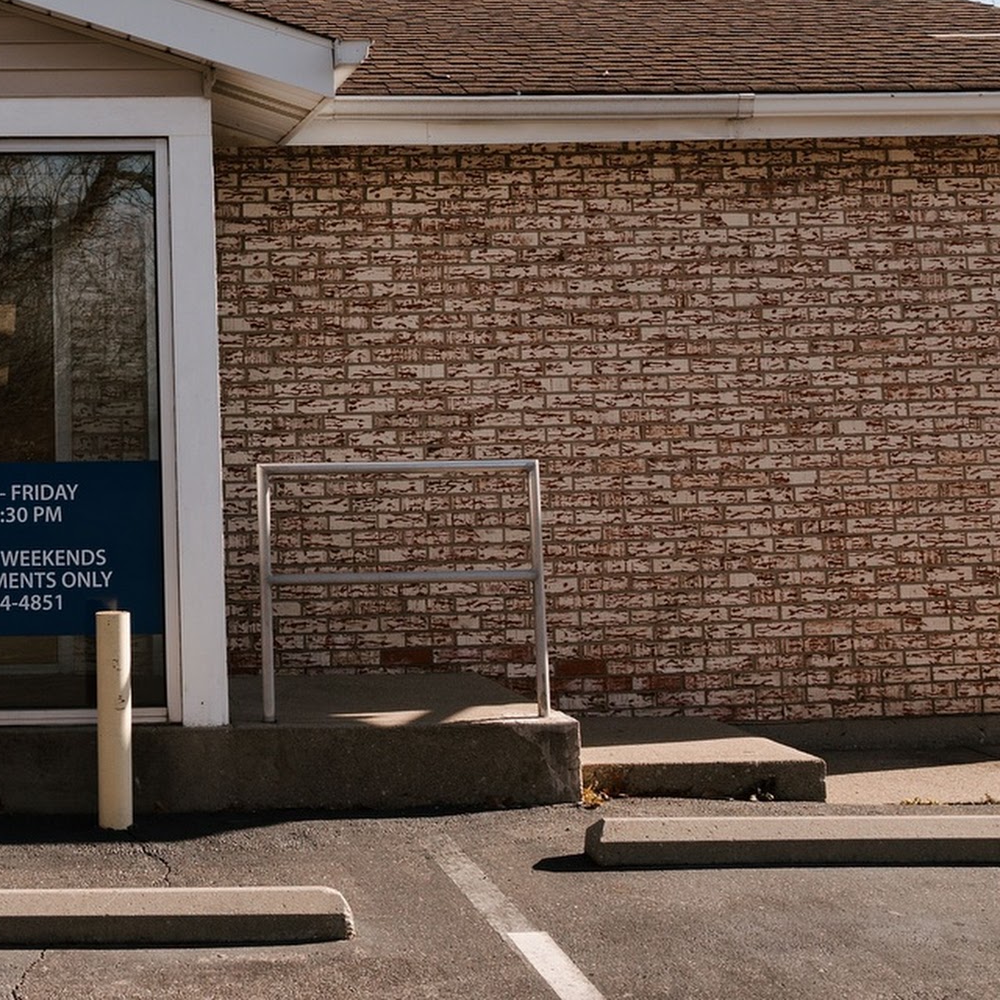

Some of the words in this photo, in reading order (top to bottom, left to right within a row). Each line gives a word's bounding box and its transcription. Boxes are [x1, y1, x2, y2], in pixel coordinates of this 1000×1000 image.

[11, 484, 78, 501] FRIDAY
[34, 506, 62, 522] PM
[1, 549, 106, 566] WEEKENDS
[61, 571, 113, 588] ONLY
